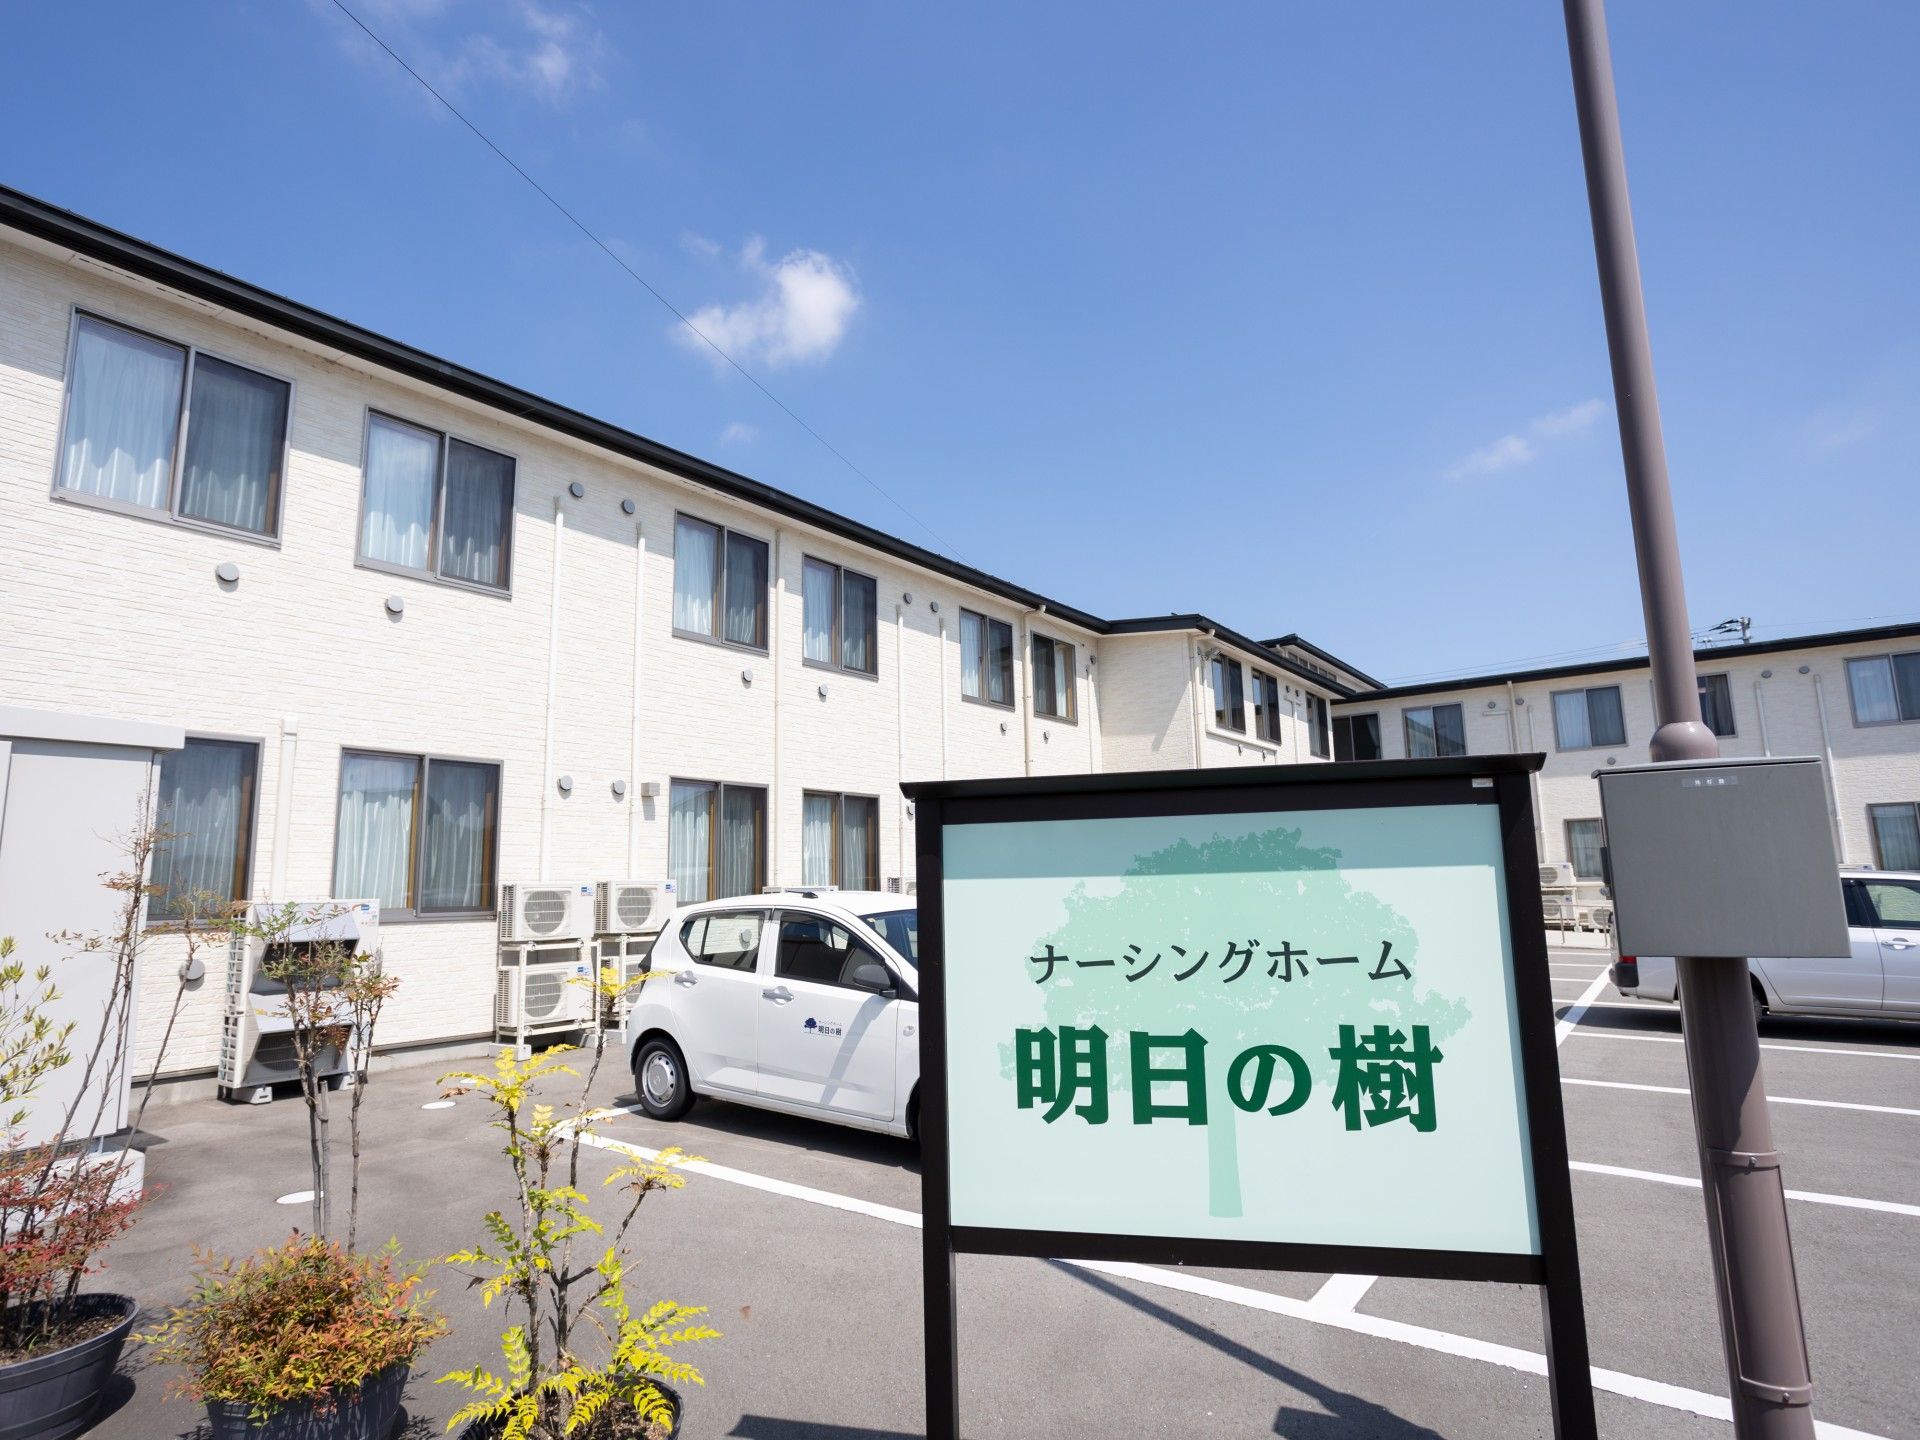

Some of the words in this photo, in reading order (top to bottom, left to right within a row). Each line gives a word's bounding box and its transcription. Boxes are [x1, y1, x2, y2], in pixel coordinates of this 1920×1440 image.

[1029, 938, 1412, 985] ナーシングホーム
[818, 1025, 842, 1036] 明日の樹
[1015, 1023, 1444, 1133] 明日の樹
